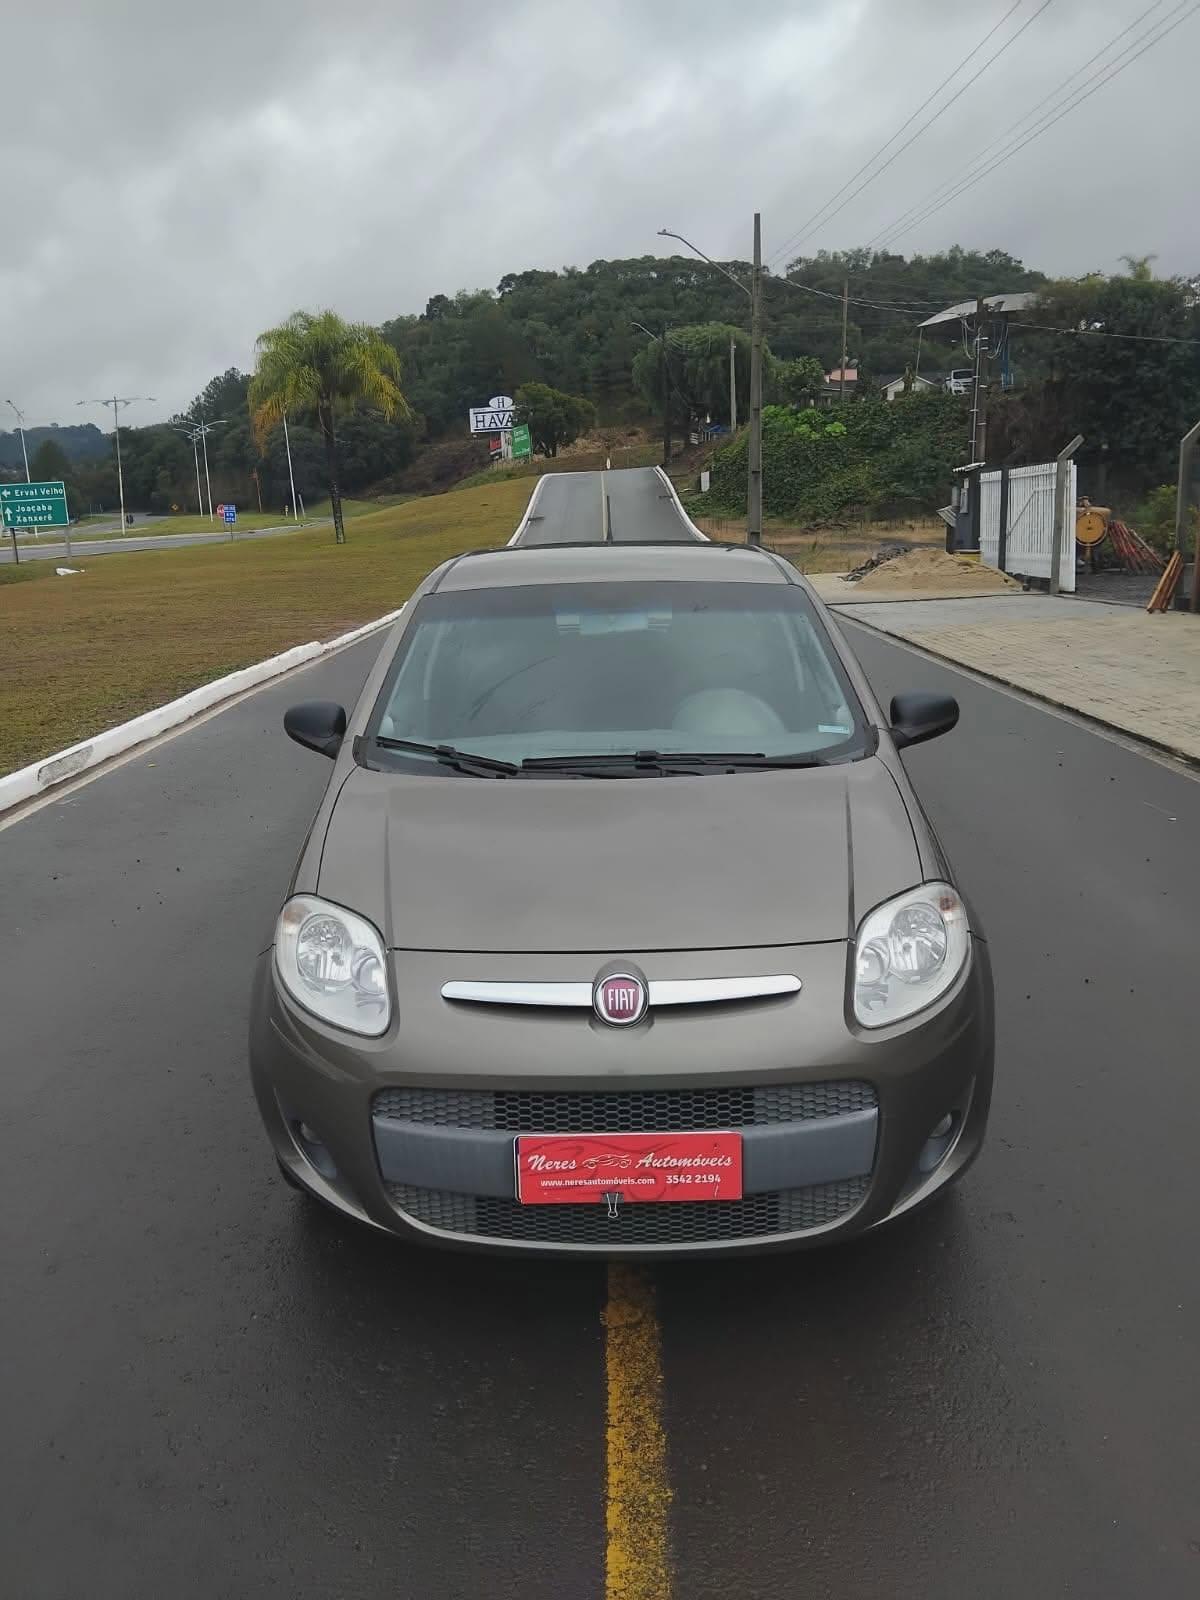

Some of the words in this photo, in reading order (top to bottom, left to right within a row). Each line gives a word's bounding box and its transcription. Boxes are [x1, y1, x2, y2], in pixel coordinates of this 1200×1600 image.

[497, 397, 505, 408] H
[475, 413, 513, 428] HAVA
[15, 504, 53, 512] Joaçaba
[608, 988, 636, 1011] FIAT
[527, 1154, 577, 1171] Neres
[635, 1152, 733, 1169] Automóveis
[665, 1174, 692, 1185] 3542
[694, 1173, 722, 1184] 2194
